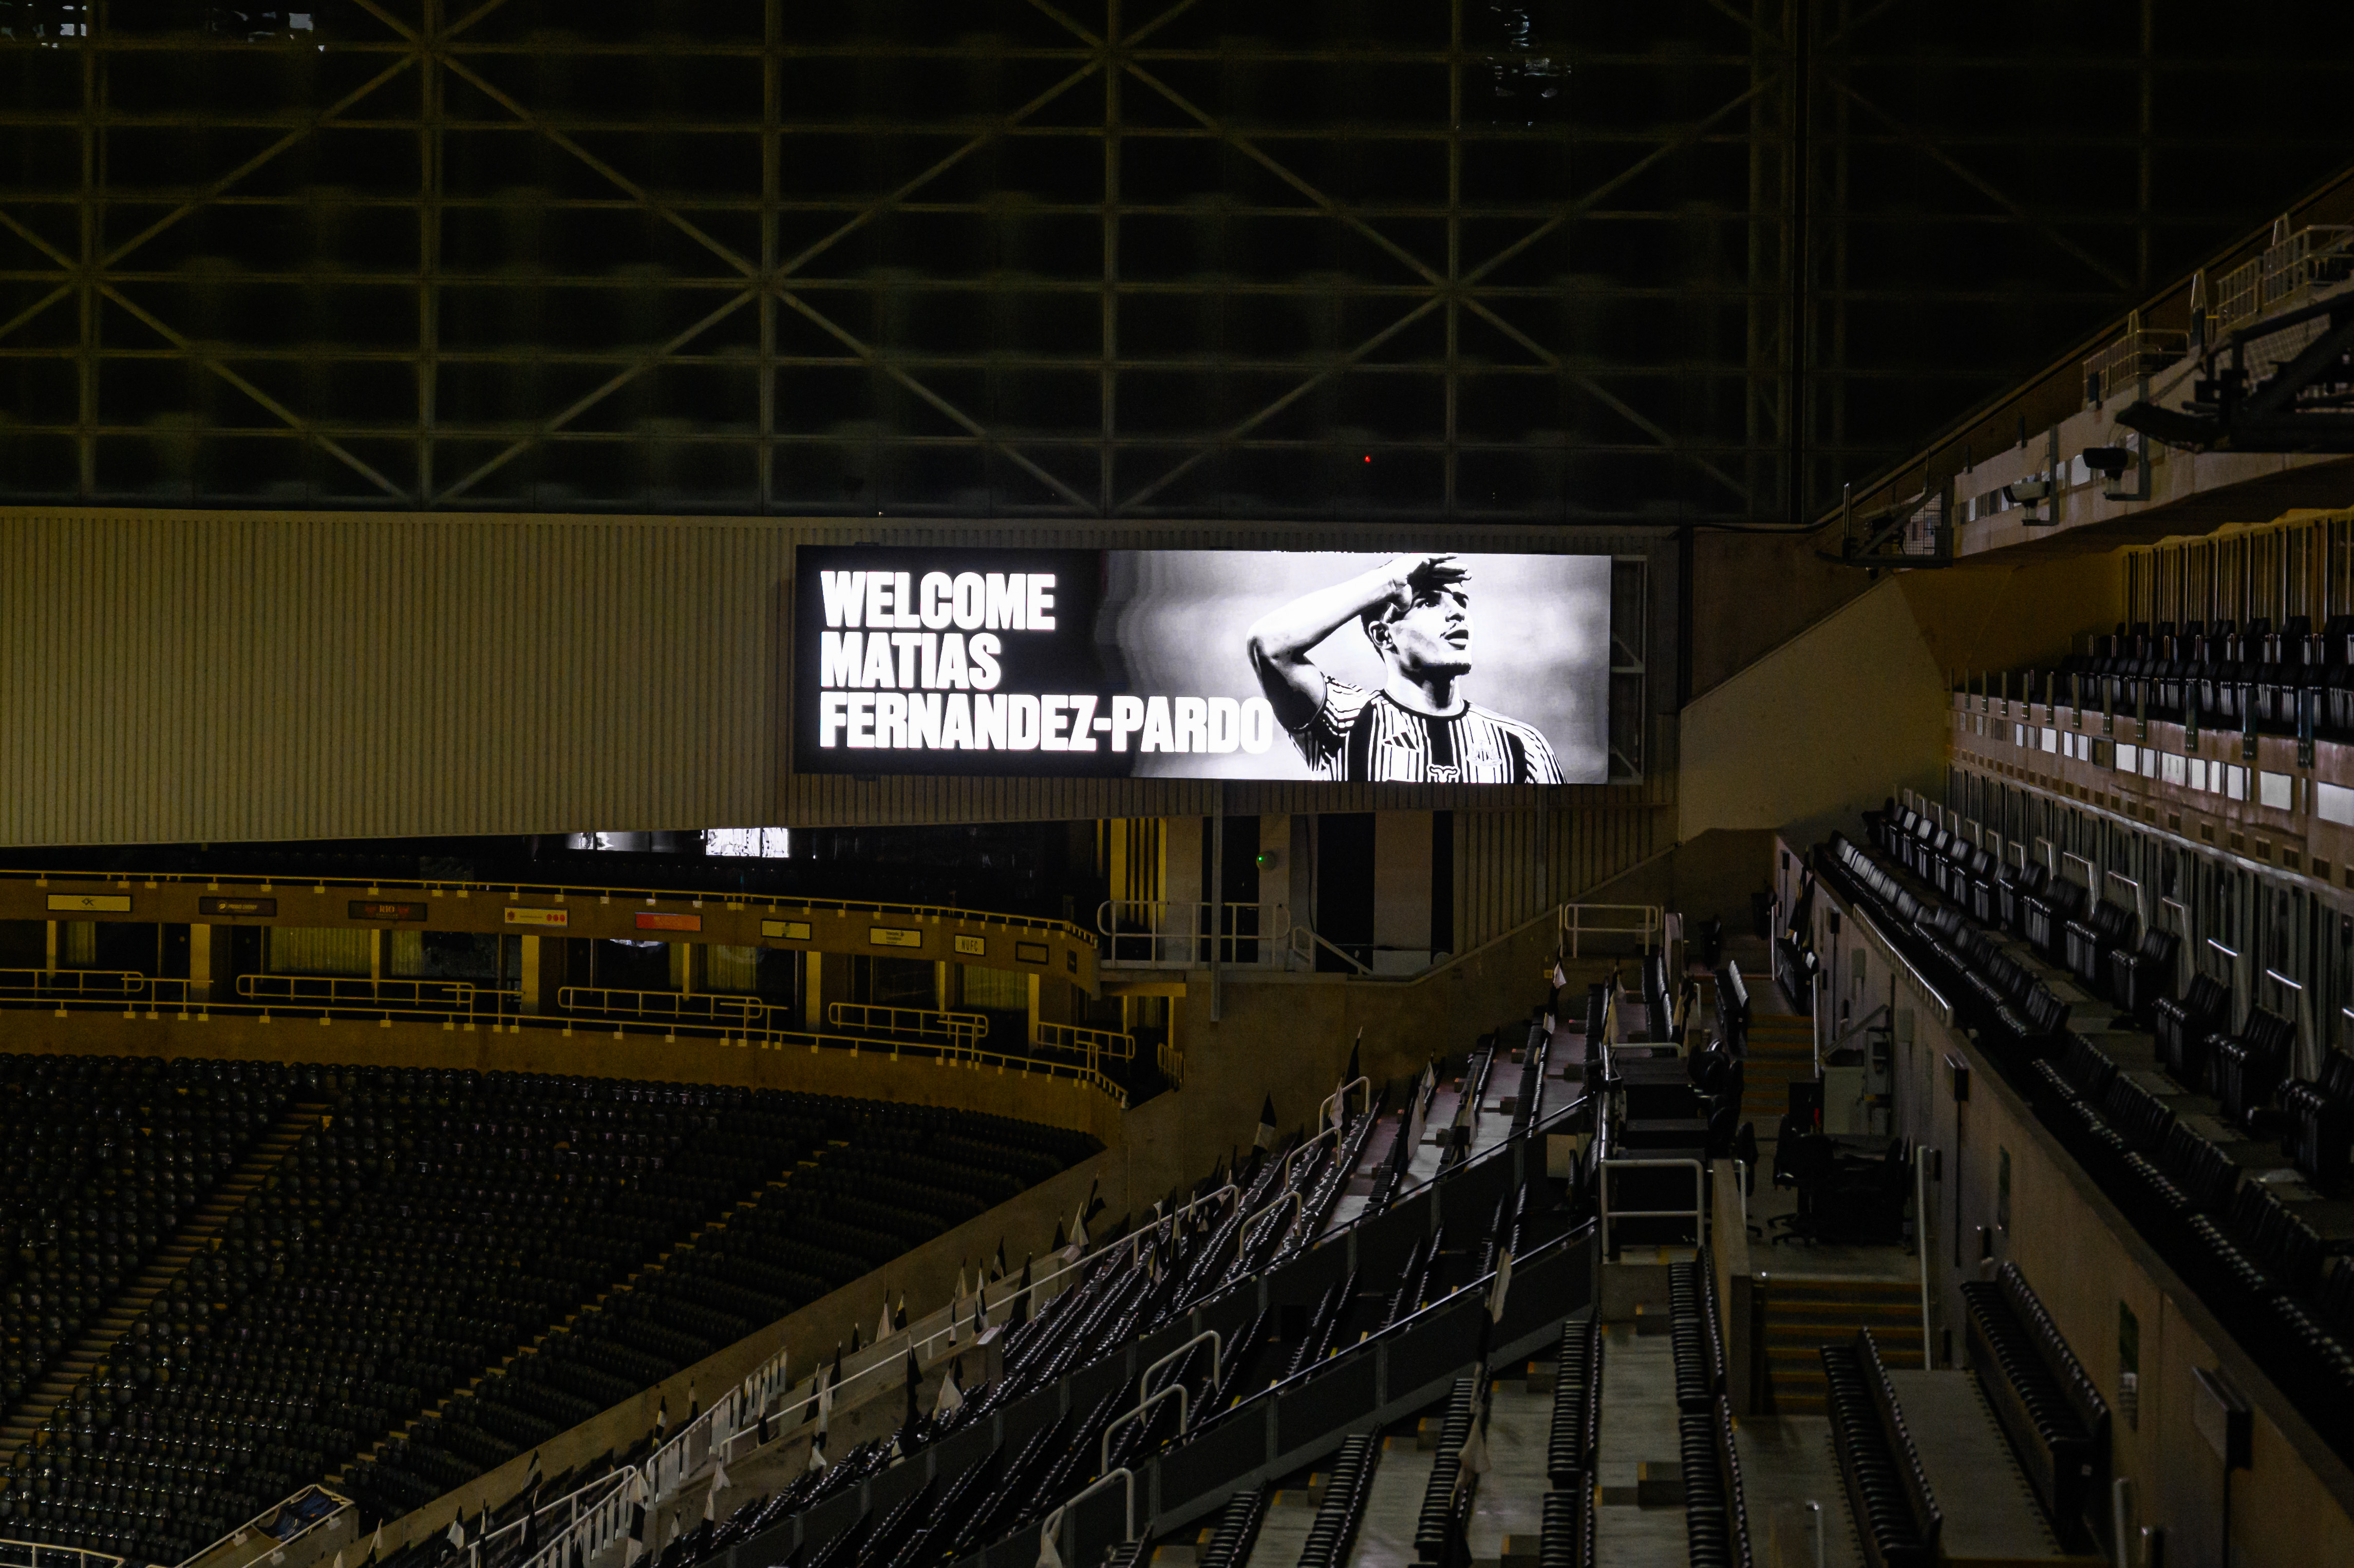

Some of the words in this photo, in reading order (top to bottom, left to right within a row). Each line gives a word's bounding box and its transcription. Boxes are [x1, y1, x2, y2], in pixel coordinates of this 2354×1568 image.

[820, 571, 1056, 630] WELCOME
[820, 631, 1001, 690] MATIAS
[820, 692, 1273, 753] FERNANDEZ-PARDO
[379, 904, 396, 913] RIO
[962, 939, 978, 952] NUFC
